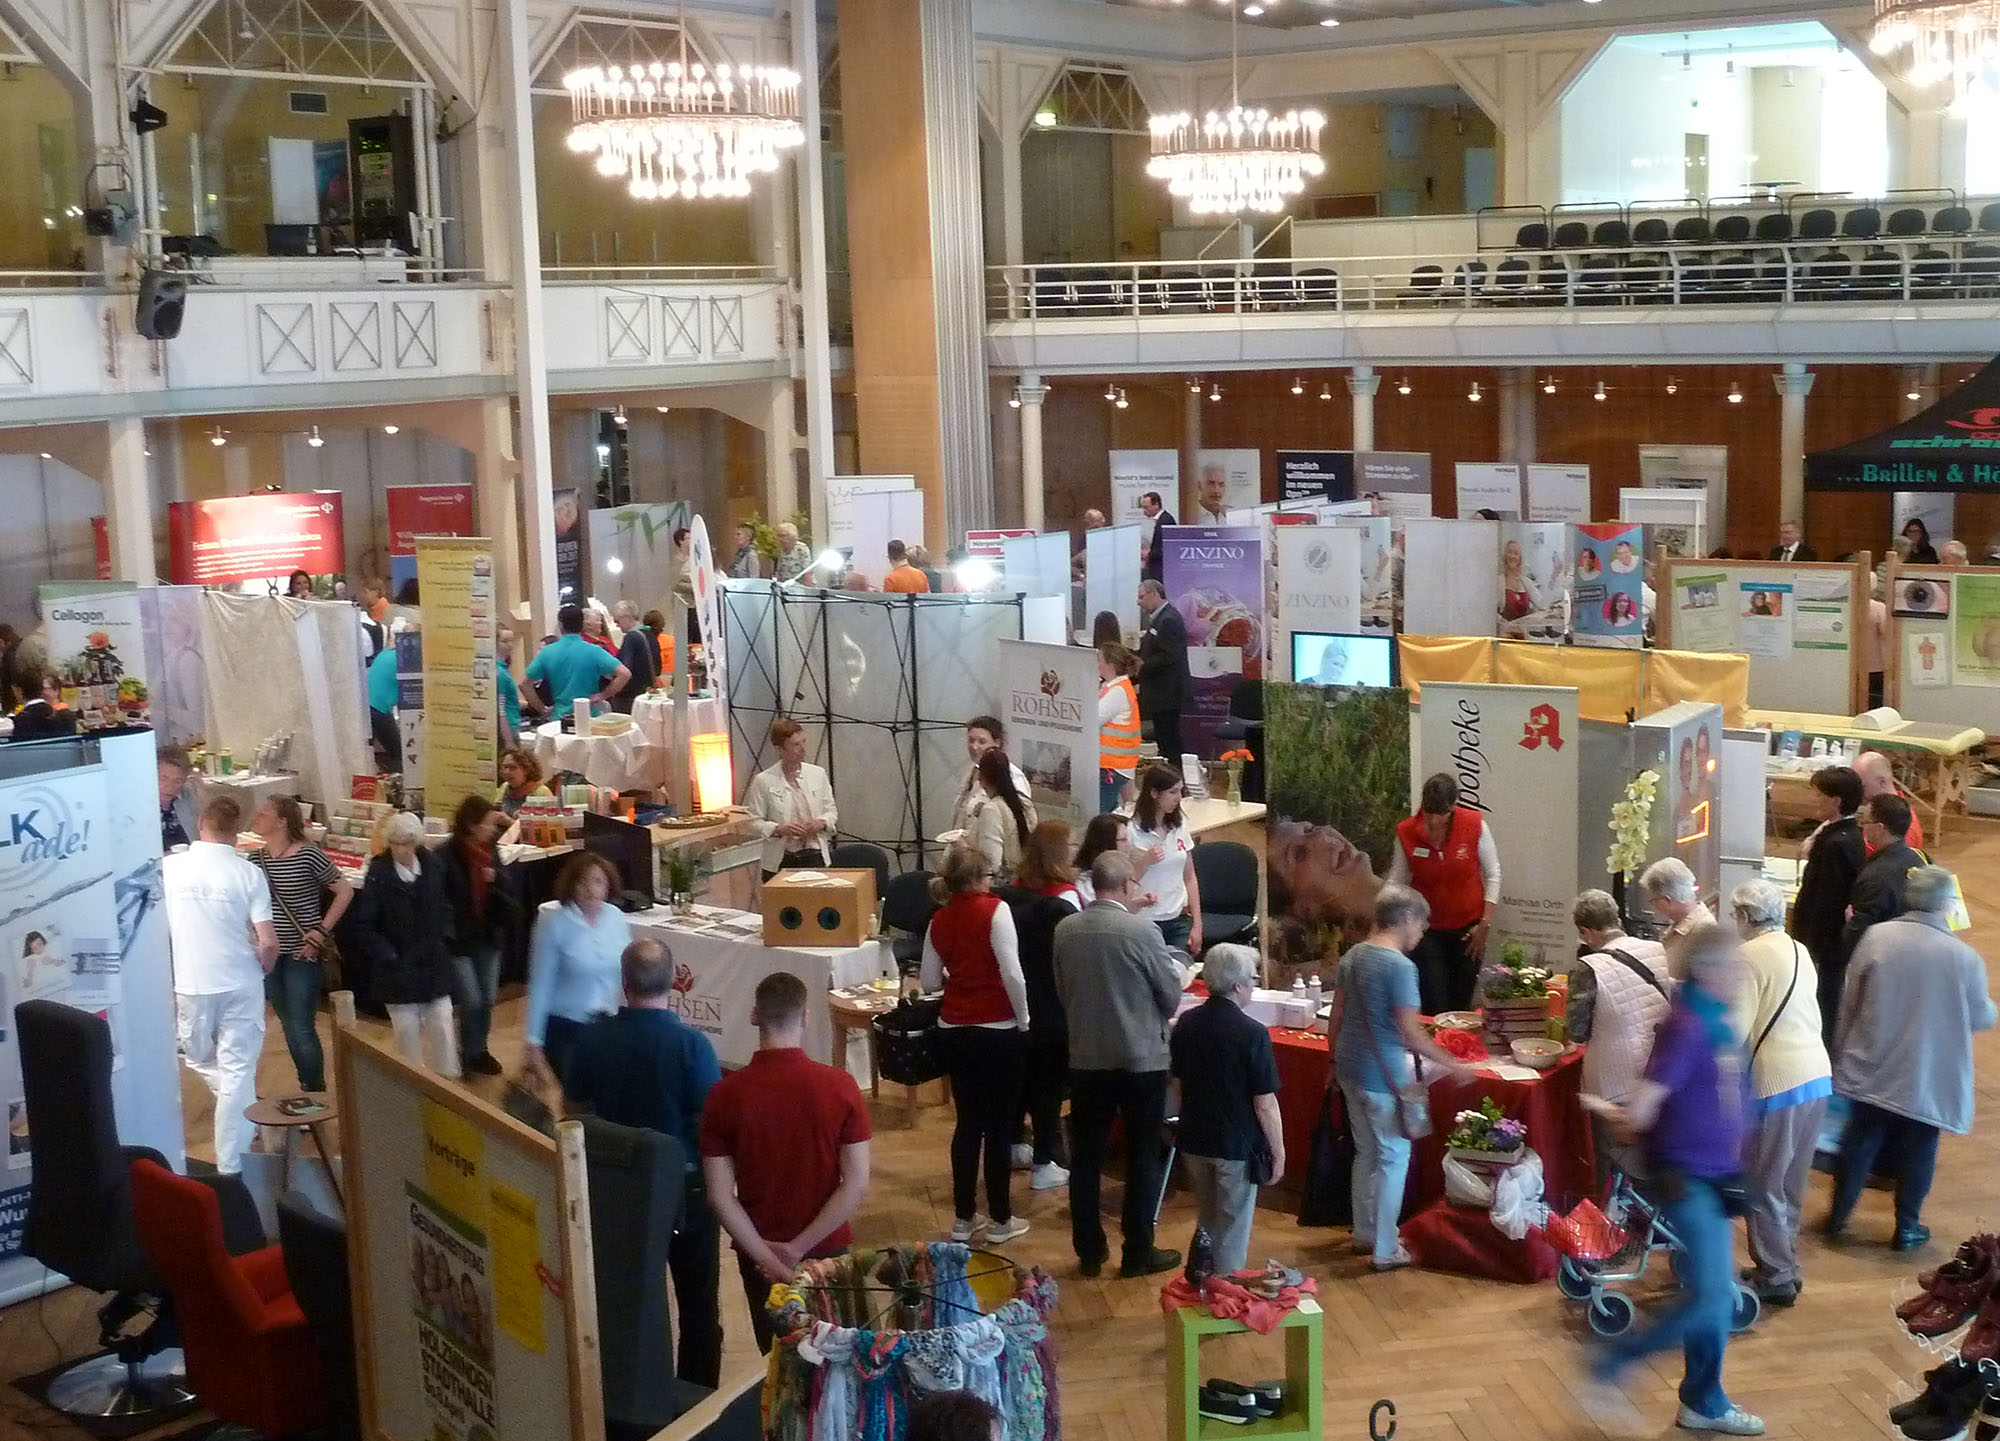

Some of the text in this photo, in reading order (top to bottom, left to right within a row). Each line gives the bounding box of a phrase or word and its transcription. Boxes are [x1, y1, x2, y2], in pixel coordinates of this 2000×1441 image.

[1285, 462, 1319, 470] Herzlich
[1285, 471, 1336, 480] willkommen
[1946, 463, 1964, 483] &
[1180, 546, 1244, 559] ZINZINO
[1286, 593, 1350, 609] ZINZINO
[1012, 694, 1082, 721] ROHSEN
[1451, 699, 1492, 814] potheke
[0, 809, 47, 848] K
[20, 819, 91, 864] ade!
[667, 996, 721, 1022] HSEN
